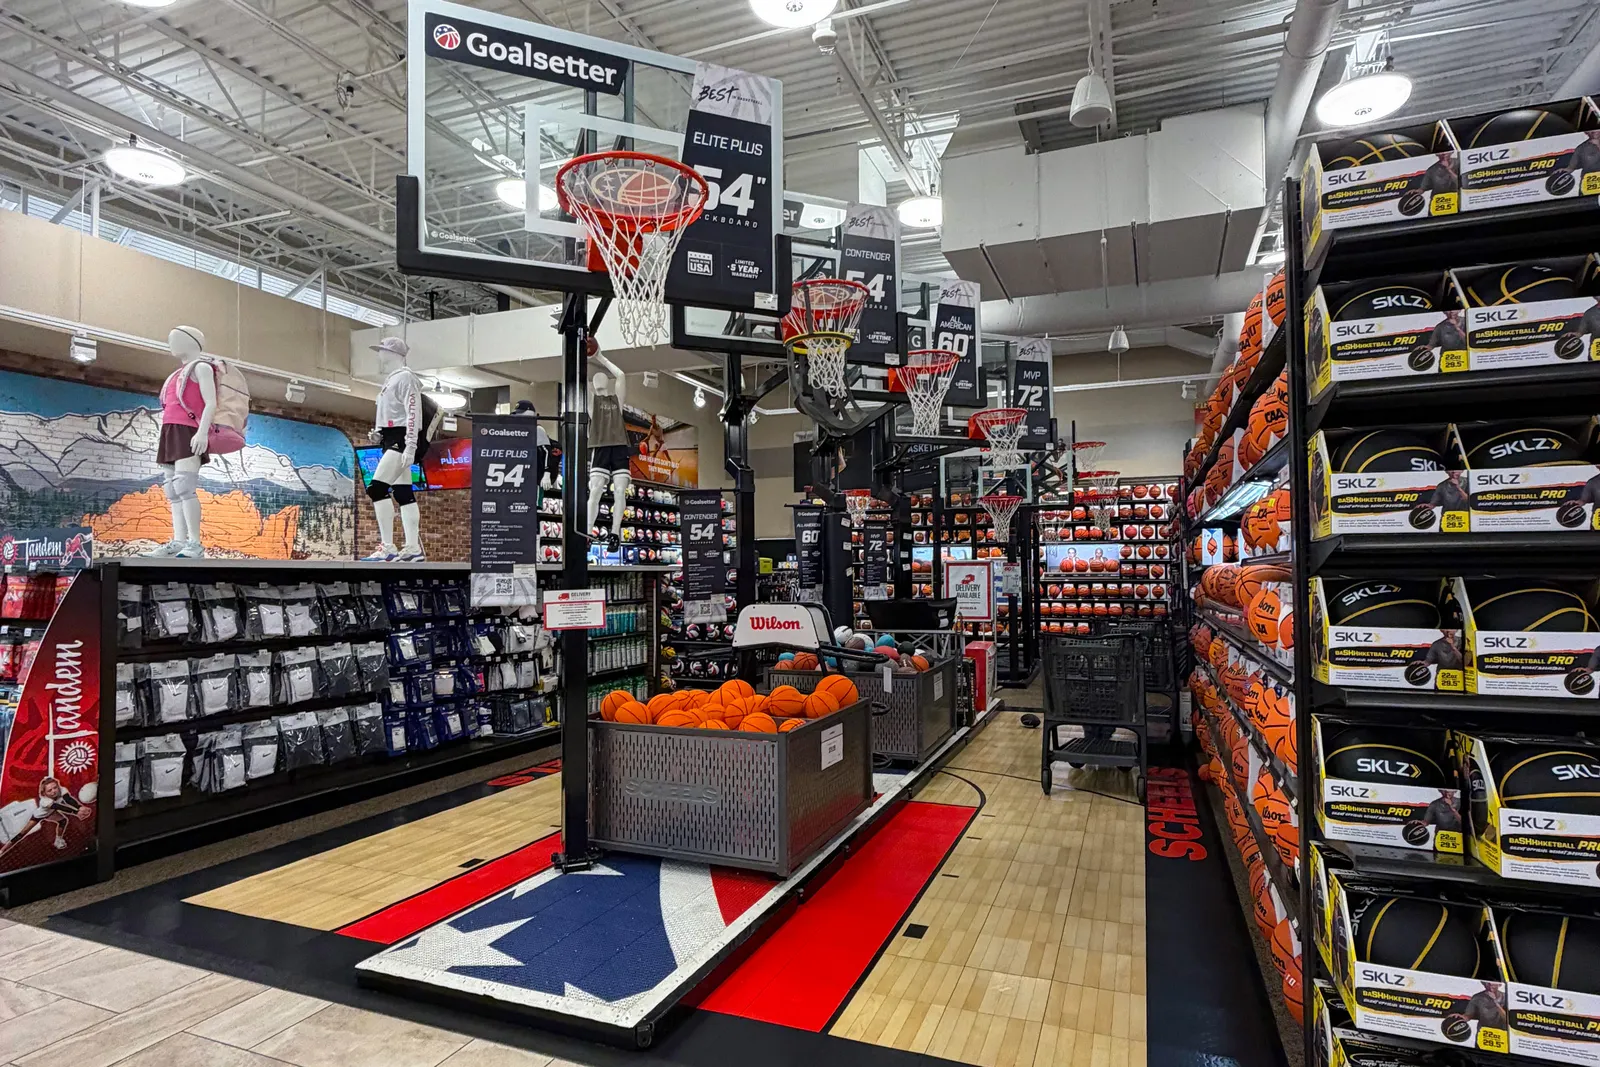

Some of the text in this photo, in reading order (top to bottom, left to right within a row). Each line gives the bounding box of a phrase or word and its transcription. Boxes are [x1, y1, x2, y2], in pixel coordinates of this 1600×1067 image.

[466, 32, 617, 86] Goalsetter
[698, 85, 739, 104] BEST
[693, 131, 763, 156] ELITE PLUS
[1468, 149, 1509, 164] SKLZ
[1529, 159, 1555, 170] PRO
[1328, 171, 1366, 185] SKLZ
[690, 164, 767, 216] 54"
[1384, 181, 1408, 191] PRO
[783, 208, 798, 221] er
[703, 214, 758, 229] CKBOARD
[849, 215, 874, 228] BEST
[845, 248, 891, 262] CONTENDER
[689, 262, 711, 274] USA
[738, 264, 760, 275] YEAR
[1266, 288, 1284, 307] CAA
[1372, 294, 1424, 311] SKLZ
[950, 315, 961, 323] ALL
[1475, 309, 1517, 323] SKLZ
[939, 320, 972, 331] AMERICAN
[1337, 323, 1375, 336] SKLZ
[1538, 322, 1564, 332] PRO
[938, 331, 974, 357] 60"
[1393, 336, 1417, 345] PRO
[1023, 370, 1041, 380] MVP
[1018, 385, 1048, 406] 72"
[488, 428, 529, 437] Goalsetter
[480, 448, 529, 459] ELITE PLUS
[1489, 437, 1551, 460] SKLZ
[1410, 457, 1445, 472] SKL
[485, 463, 531, 488] 54"
[1477, 474, 1520, 485] SKLZ
[1338, 479, 1376, 489] SKLZ
[1540, 490, 1566, 499] PRO
[683, 513, 718, 521] CONTENDER
[689, 523, 719, 541] 54"
[12, 537, 62, 566] Tandem
[955, 584, 980, 592] DELIVERY
[956, 591, 980, 599] AVAILABLE
[1342, 583, 1390, 607] SKLZ
[749, 616, 801, 631] Wilson
[1335, 632, 1372, 642] SKLZ
[1484, 638, 1527, 648] SKLZ
[1390, 650, 1414, 658] PRO
[1547, 656, 1574, 665] PRO
[44, 640, 99, 779] Tandem
[1356, 757, 1411, 777] SKLZ
[1331, 786, 1369, 798] SKLZ
[1146, 766, 1208, 861] SCHEELS
[1387, 807, 1411, 816] PRO
[1508, 816, 1555, 830] SKLZ
[1362, 970, 1405, 986] SKLZ
[1425, 998, 1452, 1009] PRO
[1516, 991, 1564, 1009] SKLZ
